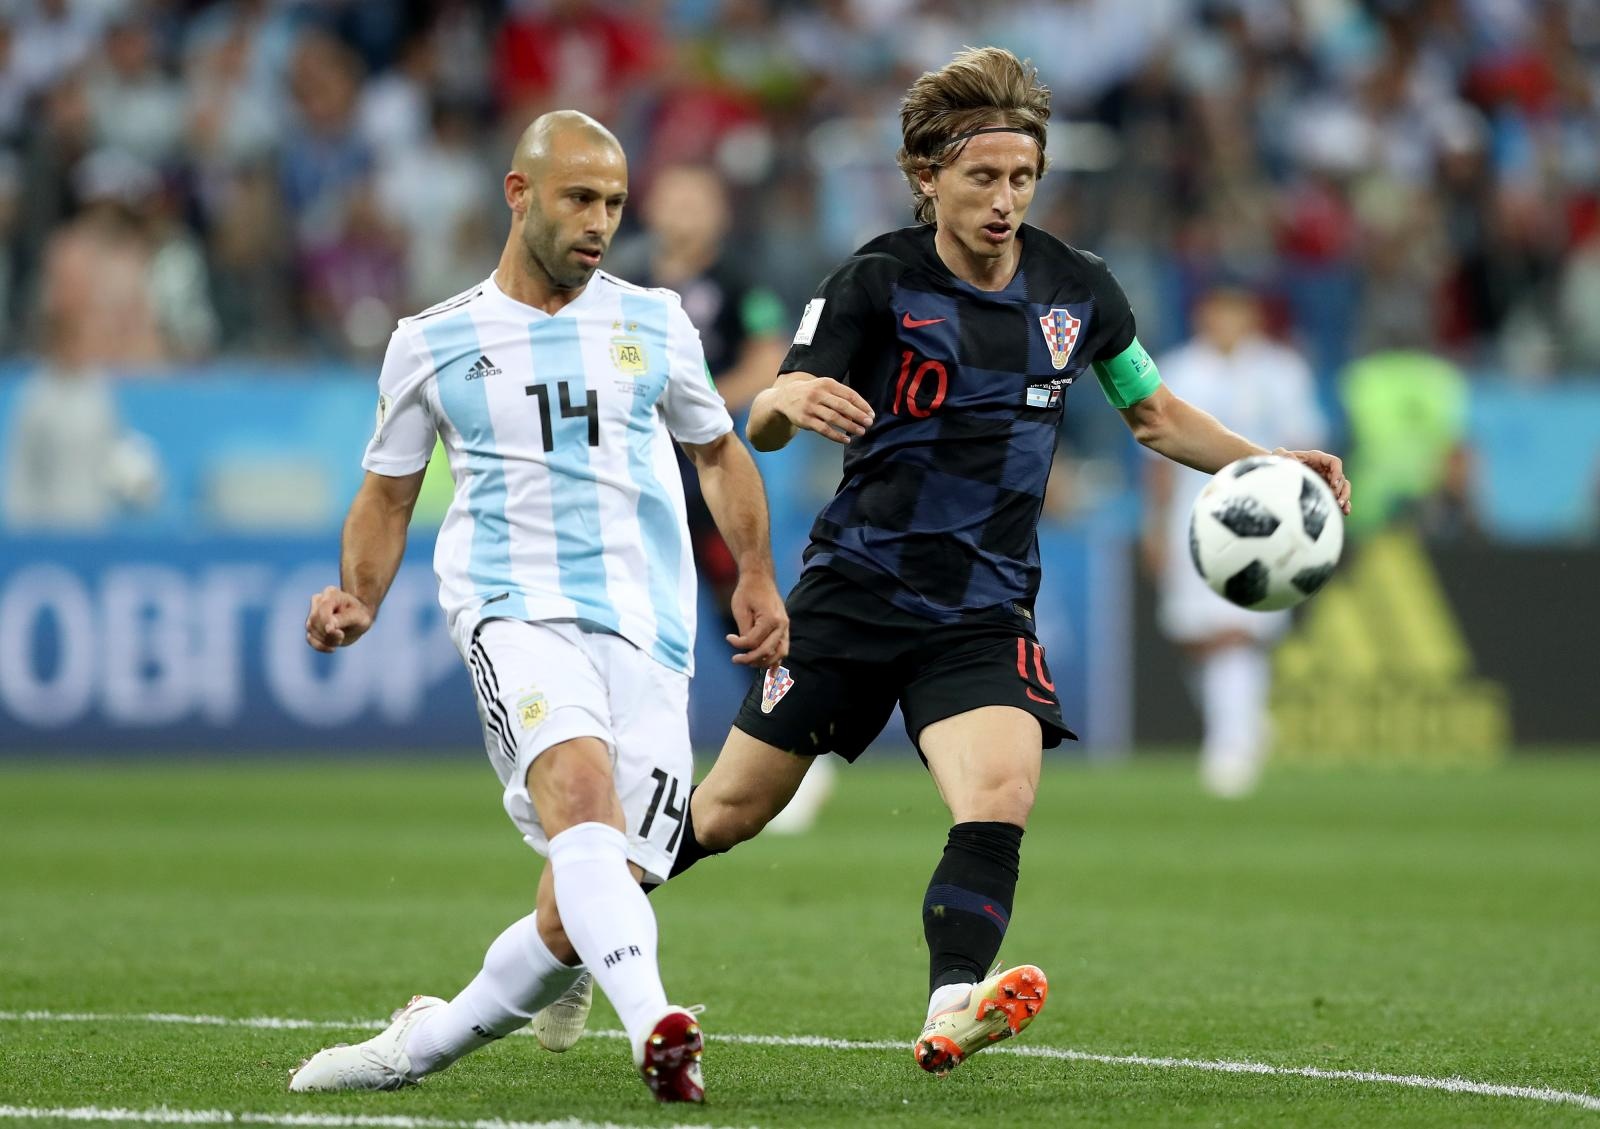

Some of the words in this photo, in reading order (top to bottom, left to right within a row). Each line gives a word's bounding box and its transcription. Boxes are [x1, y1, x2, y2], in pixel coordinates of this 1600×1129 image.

[465, 367, 503, 381] adidas
[892, 350, 949, 418] 10
[525, 380, 599, 452] 14
[638, 767, 686, 853] 14
[604, 944, 642, 968] AFA
